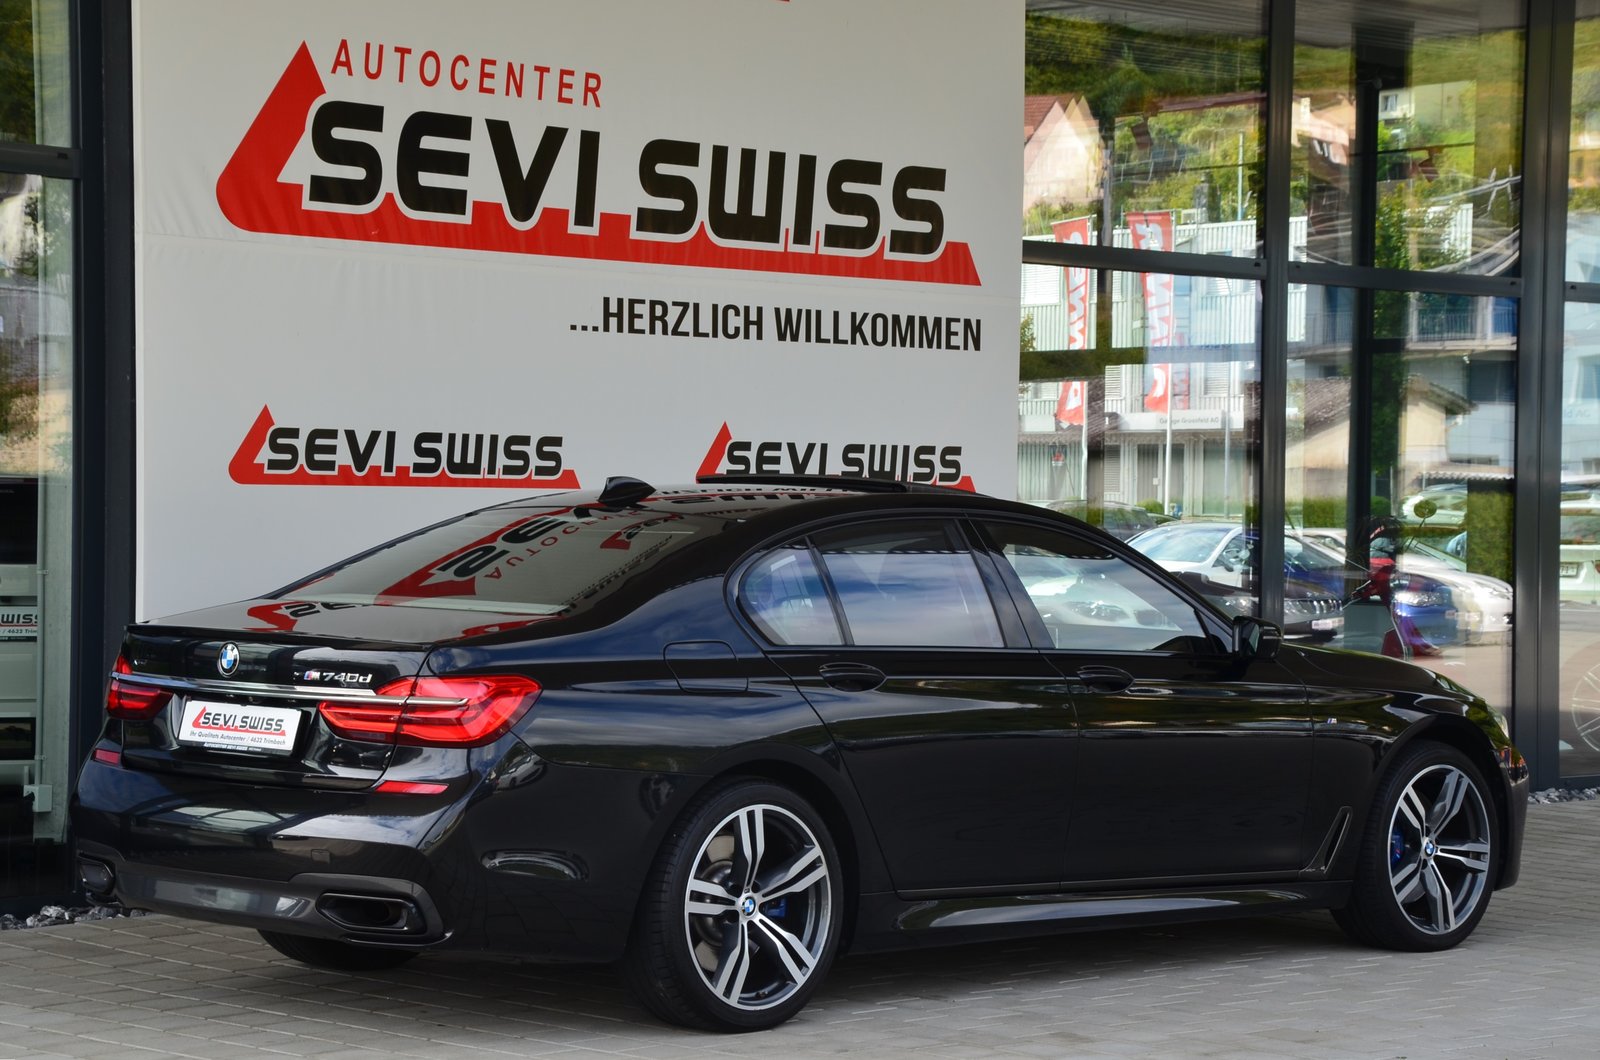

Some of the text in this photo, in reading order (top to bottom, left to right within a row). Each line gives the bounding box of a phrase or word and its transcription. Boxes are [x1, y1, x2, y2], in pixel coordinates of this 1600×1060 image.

[331, 39, 602, 108] AUTOCENTER
[309, 100, 947, 256] SEVI SWISS
[774, 306, 982, 352] WILLKOMMEN
[266, 427, 563, 478] SEVI SWISS
[726, 441, 962, 482] SEVI SWISS
[323, 672, 373, 684] 740d
[202, 712, 284, 732] SEVI SWISS
[219, 733, 246, 742] Autocenter
